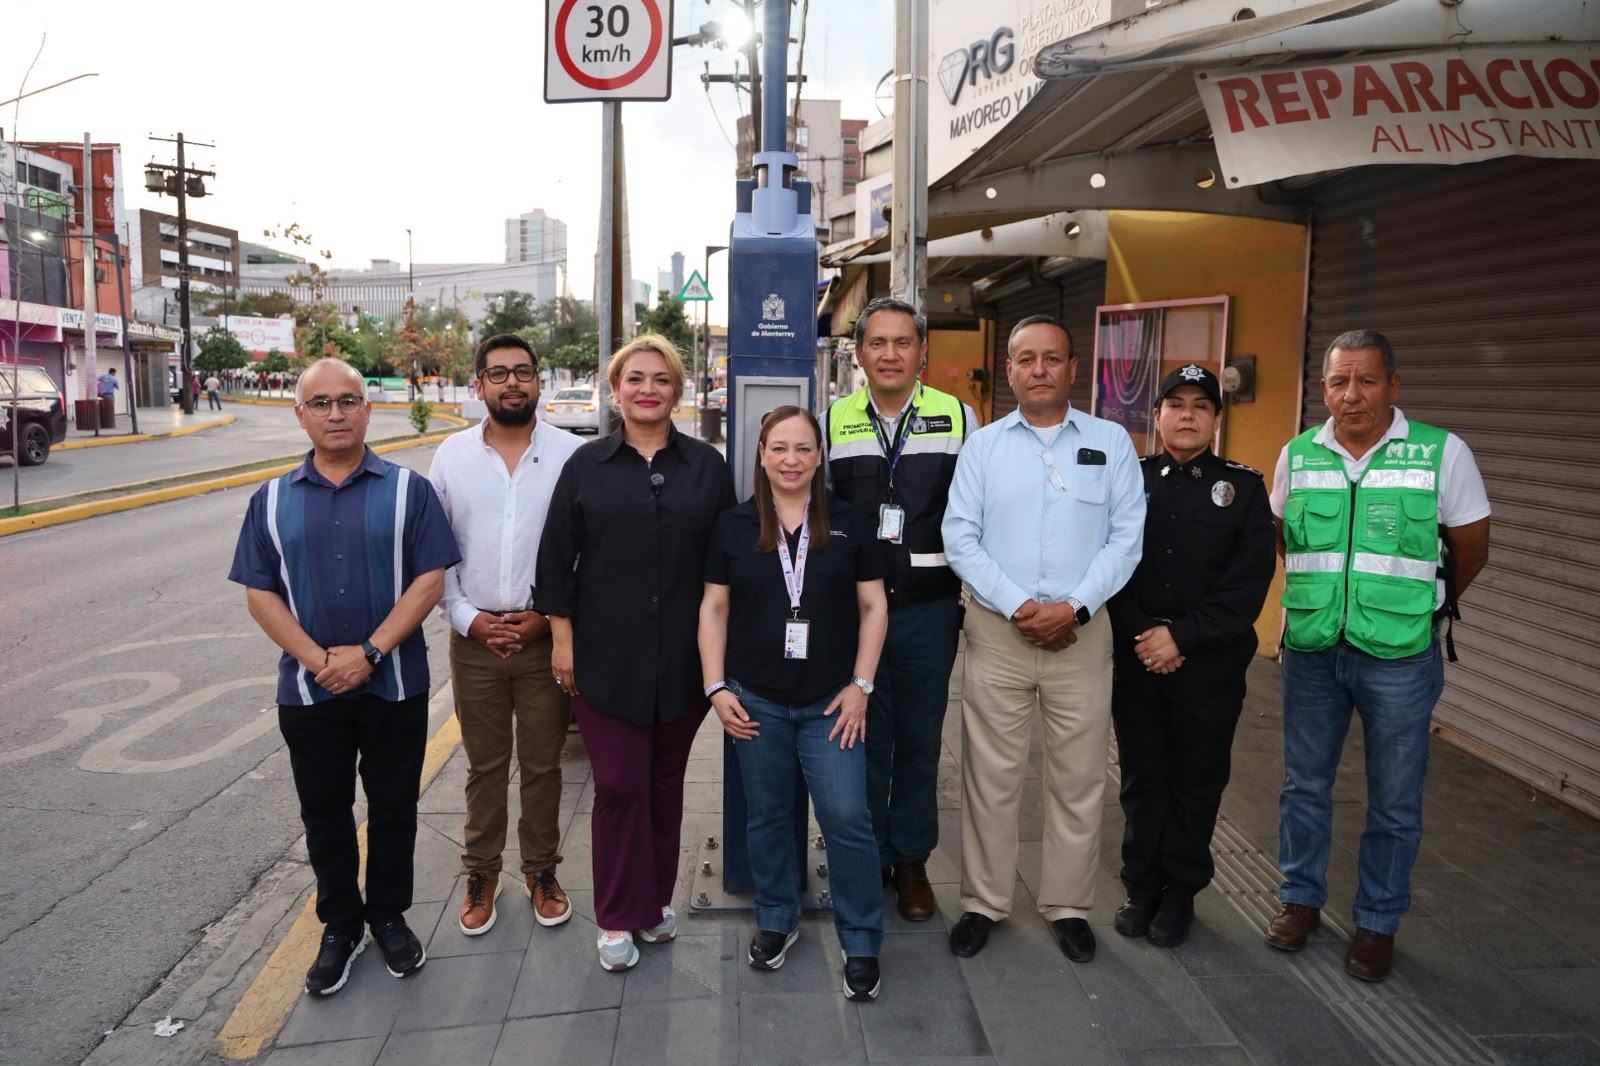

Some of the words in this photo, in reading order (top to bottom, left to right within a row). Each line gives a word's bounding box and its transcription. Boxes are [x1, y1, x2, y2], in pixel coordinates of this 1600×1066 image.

[585, 5, 629, 38] 30
[1021, 20, 1064, 57] ACERO
[1067, 1, 1100, 35] INOX
[582, 43, 631, 63] km/h
[1217, 58, 1600, 133] REPARACIO
[950, 96, 1010, 139] MAYOREO
[1014, 89, 1023, 112] Y
[1371, 122, 1424, 153] AL
[1428, 118, 1600, 152] INSTANT
[761, 330, 795, 338] Monterrey
[1385, 442, 1438, 459] MTY
